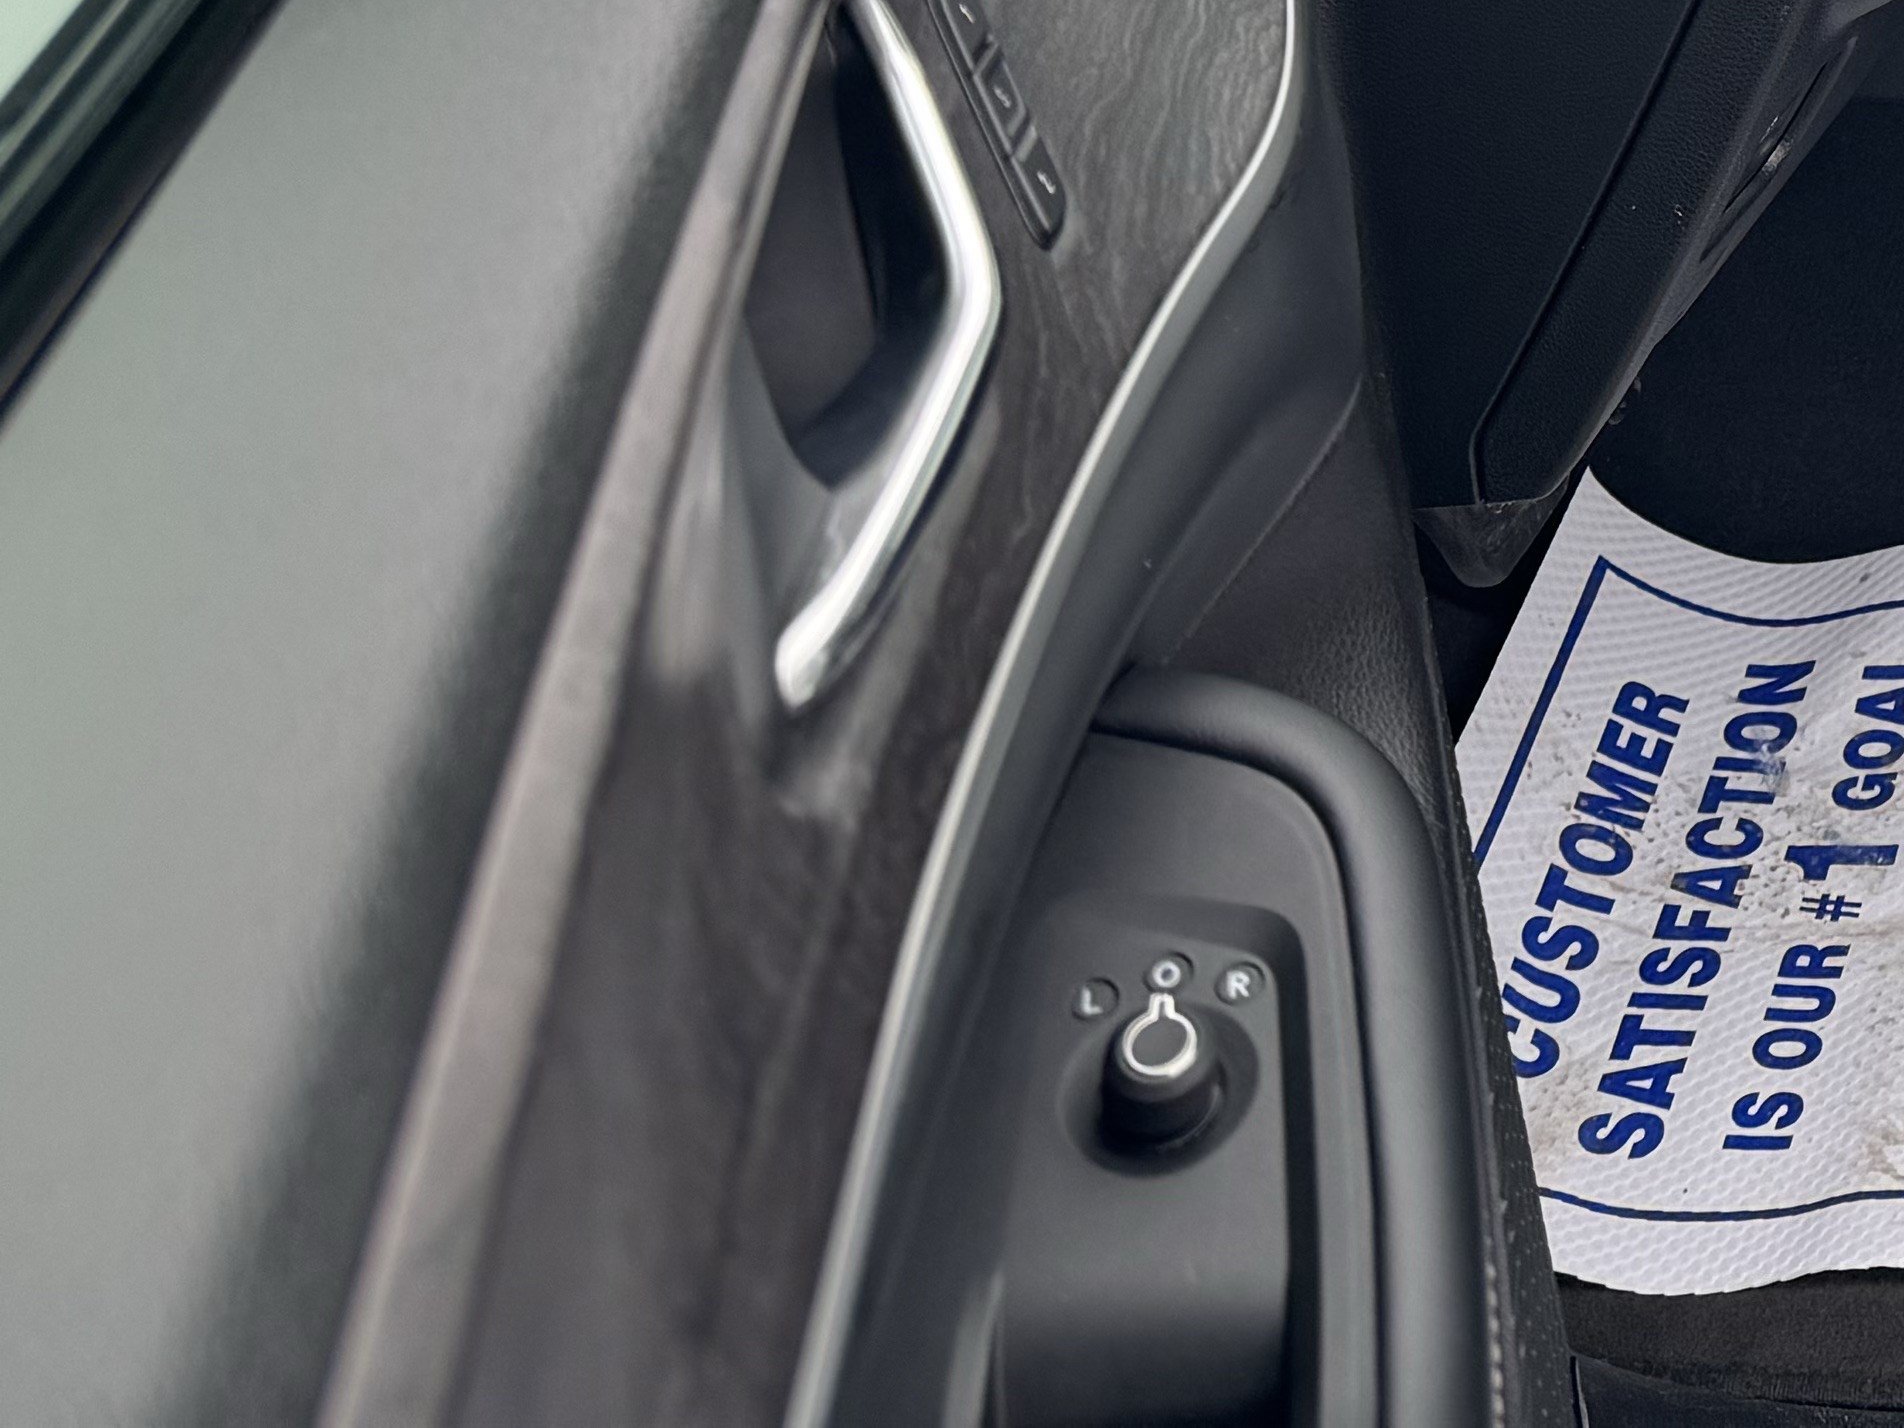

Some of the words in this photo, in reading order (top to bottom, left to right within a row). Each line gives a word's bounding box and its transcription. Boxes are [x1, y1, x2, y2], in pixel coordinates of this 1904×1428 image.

[1502, 682, 1688, 1079] CUSTOMER
[1579, 662, 1815, 1159] SATISFACTION
[1787, 844, 1898, 922] #1
[1080, 987, 1103, 1015] L
[1227, 970, 1250, 999] R
[1754, 943, 1847, 1070] OUR
[1724, 1092, 1803, 1152] IS
